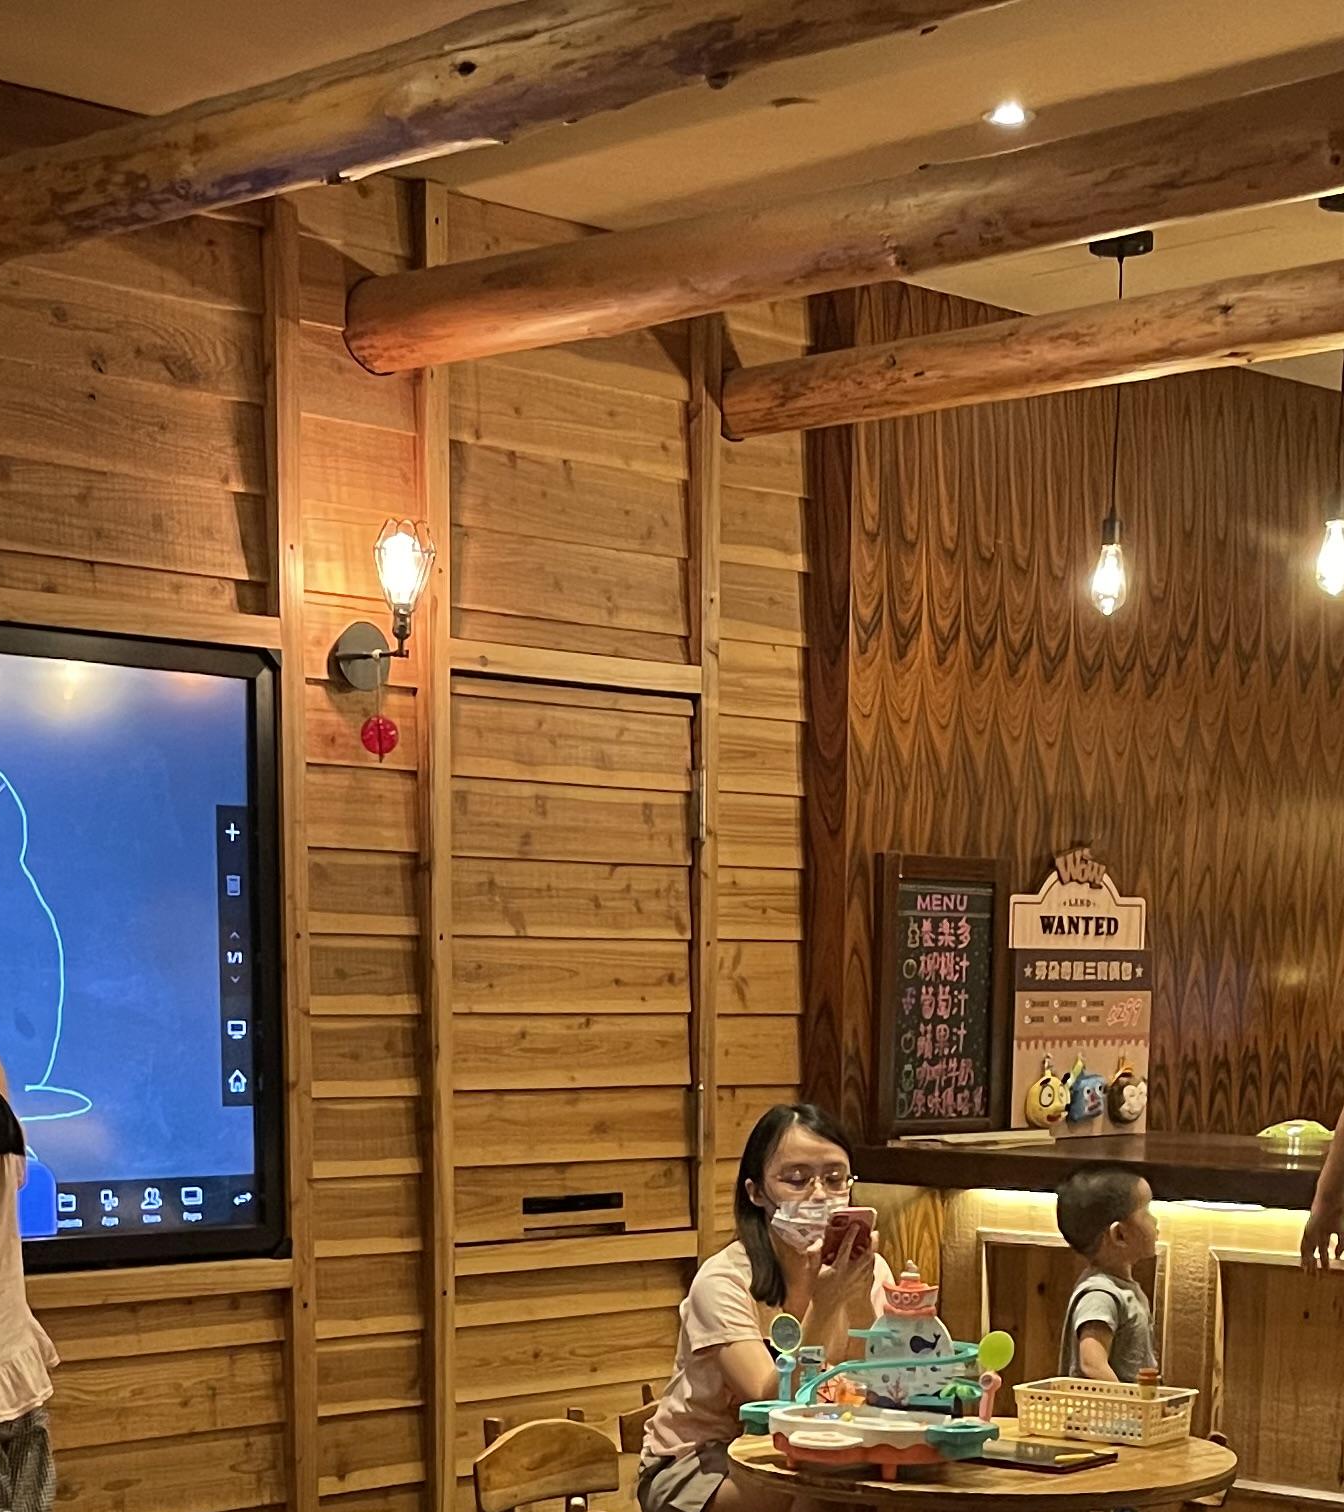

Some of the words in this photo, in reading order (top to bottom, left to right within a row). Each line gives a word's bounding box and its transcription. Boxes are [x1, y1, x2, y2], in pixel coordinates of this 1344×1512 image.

[917, 894, 968, 911] MENU
[1040, 915, 1119, 936] WANTED
[920, 984, 969, 1019] 葡萄汁
